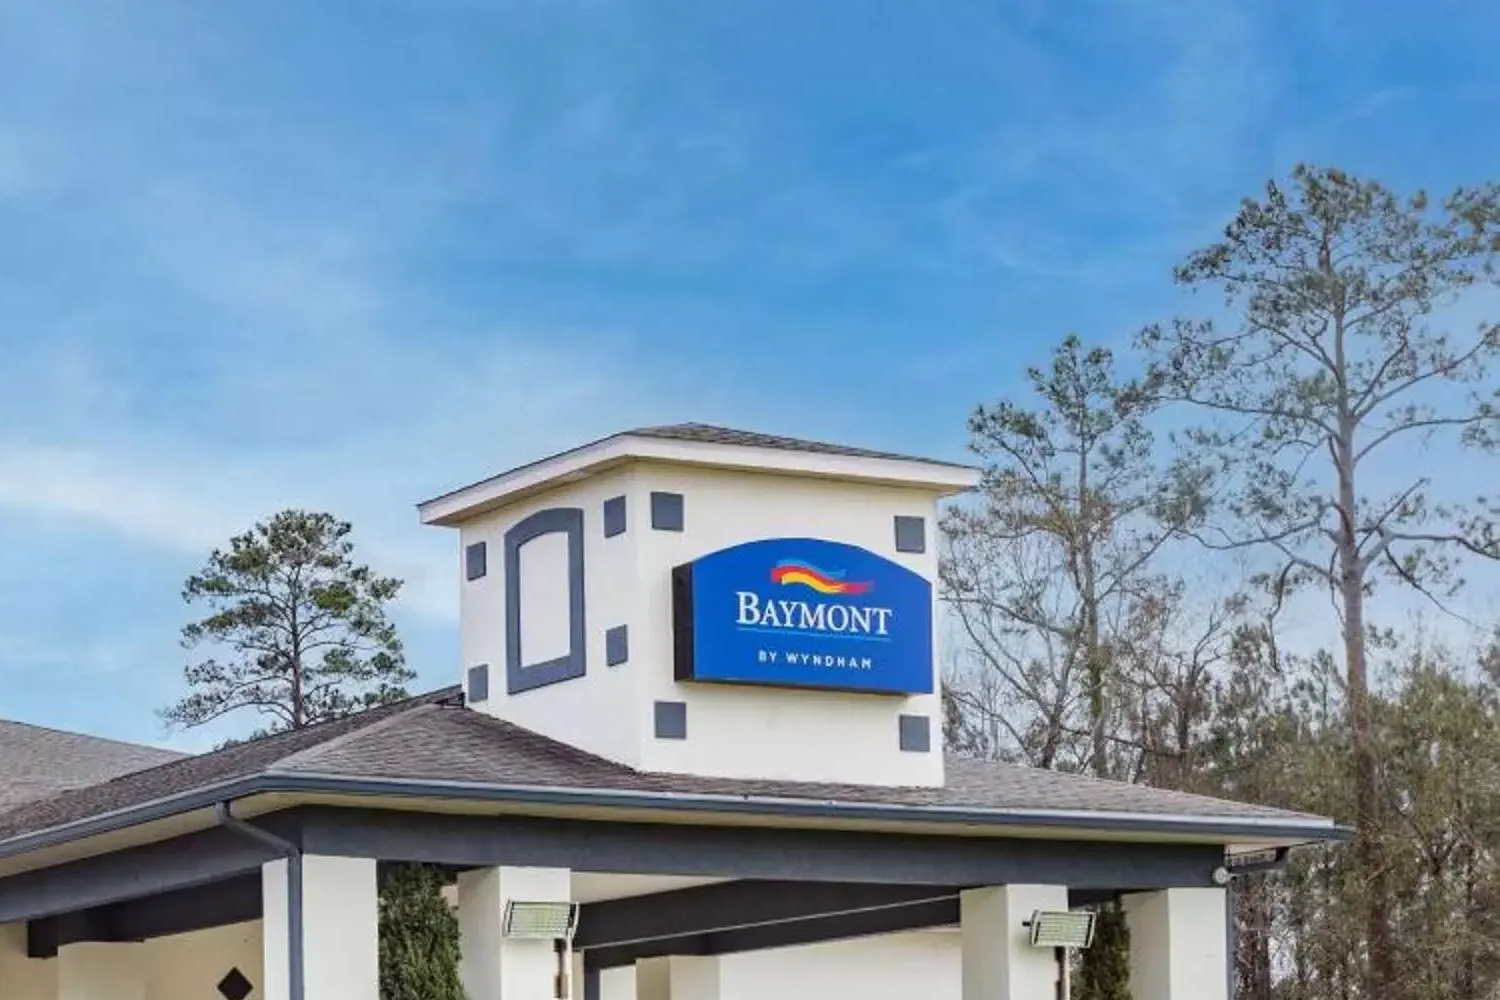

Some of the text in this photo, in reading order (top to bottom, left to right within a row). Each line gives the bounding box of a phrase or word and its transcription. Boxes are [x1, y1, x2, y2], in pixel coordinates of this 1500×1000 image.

[735, 591, 893, 635] BAYMONT
[758, 650, 872, 670] BY WYNDHAM
